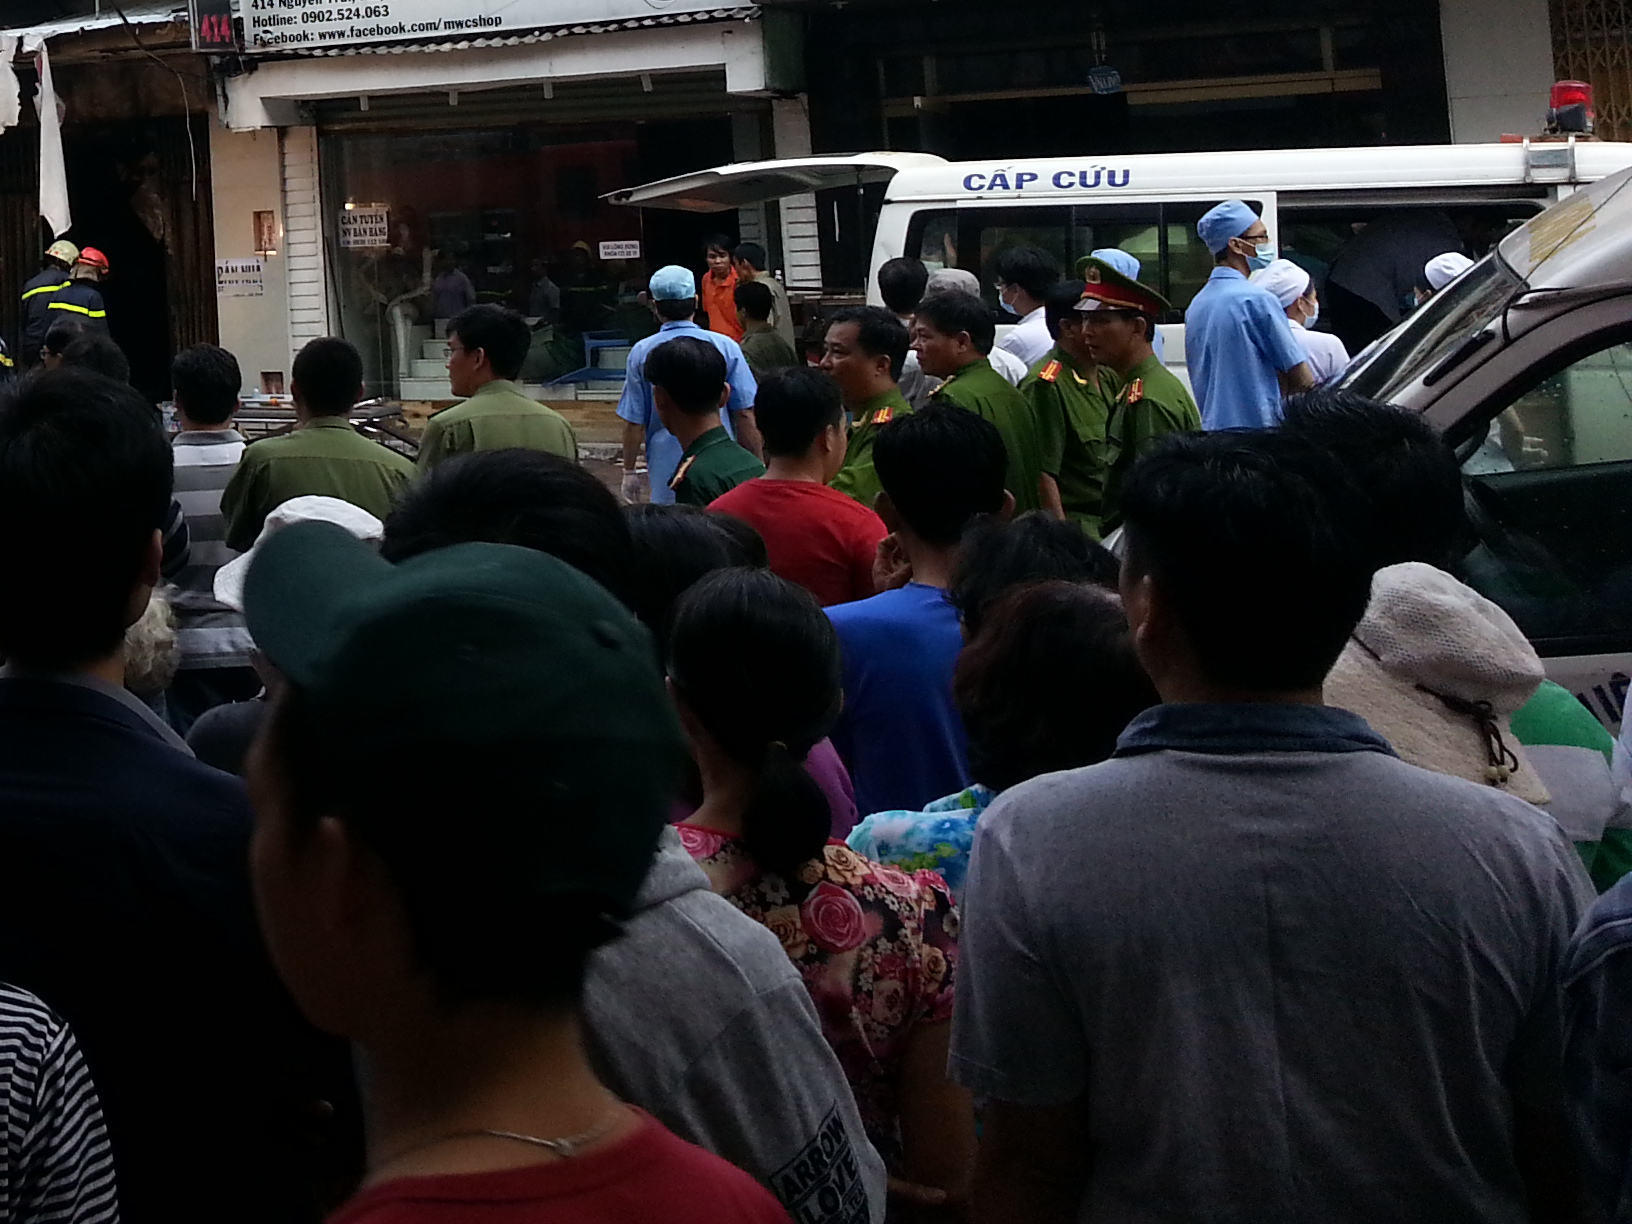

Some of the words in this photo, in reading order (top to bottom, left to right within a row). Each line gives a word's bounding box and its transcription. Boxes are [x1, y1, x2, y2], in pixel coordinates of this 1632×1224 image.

[200, 14, 230, 43] 414
[252, 13, 298, 28] Hotline:
[301, 4, 390, 24] 0902.524.063
[962, 165, 1039, 191] CẤP
[1052, 164, 1131, 189] CỨU
[781, 1114, 848, 1203] ARROW
